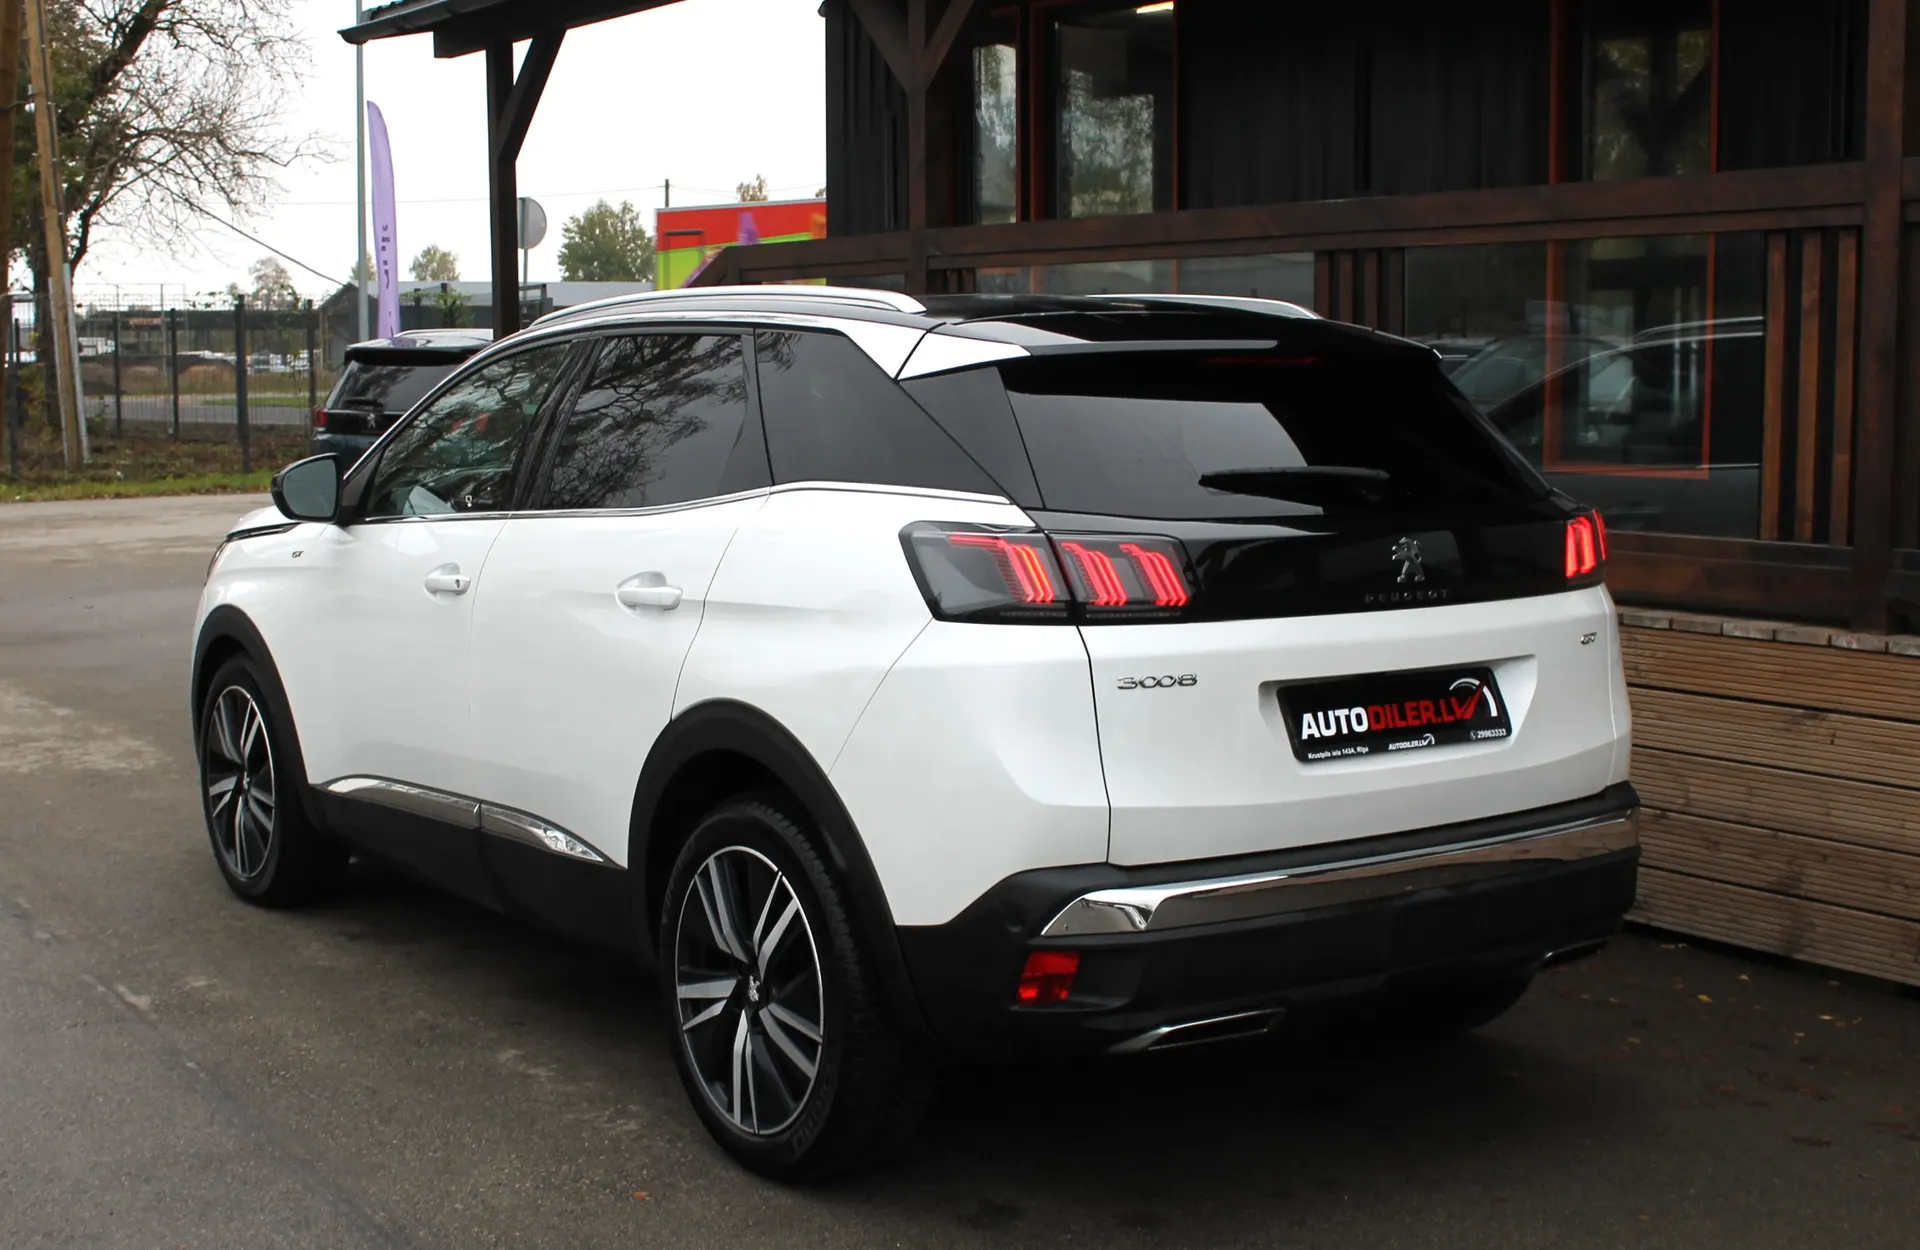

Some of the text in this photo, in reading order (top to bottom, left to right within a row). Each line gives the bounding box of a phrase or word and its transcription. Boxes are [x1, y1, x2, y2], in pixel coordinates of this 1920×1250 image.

[1364, 589, 1449, 603] PEUGEOT
[1117, 673, 1198, 690] 3008
[1301, 681, 1485, 740] AUTODILER.LV
